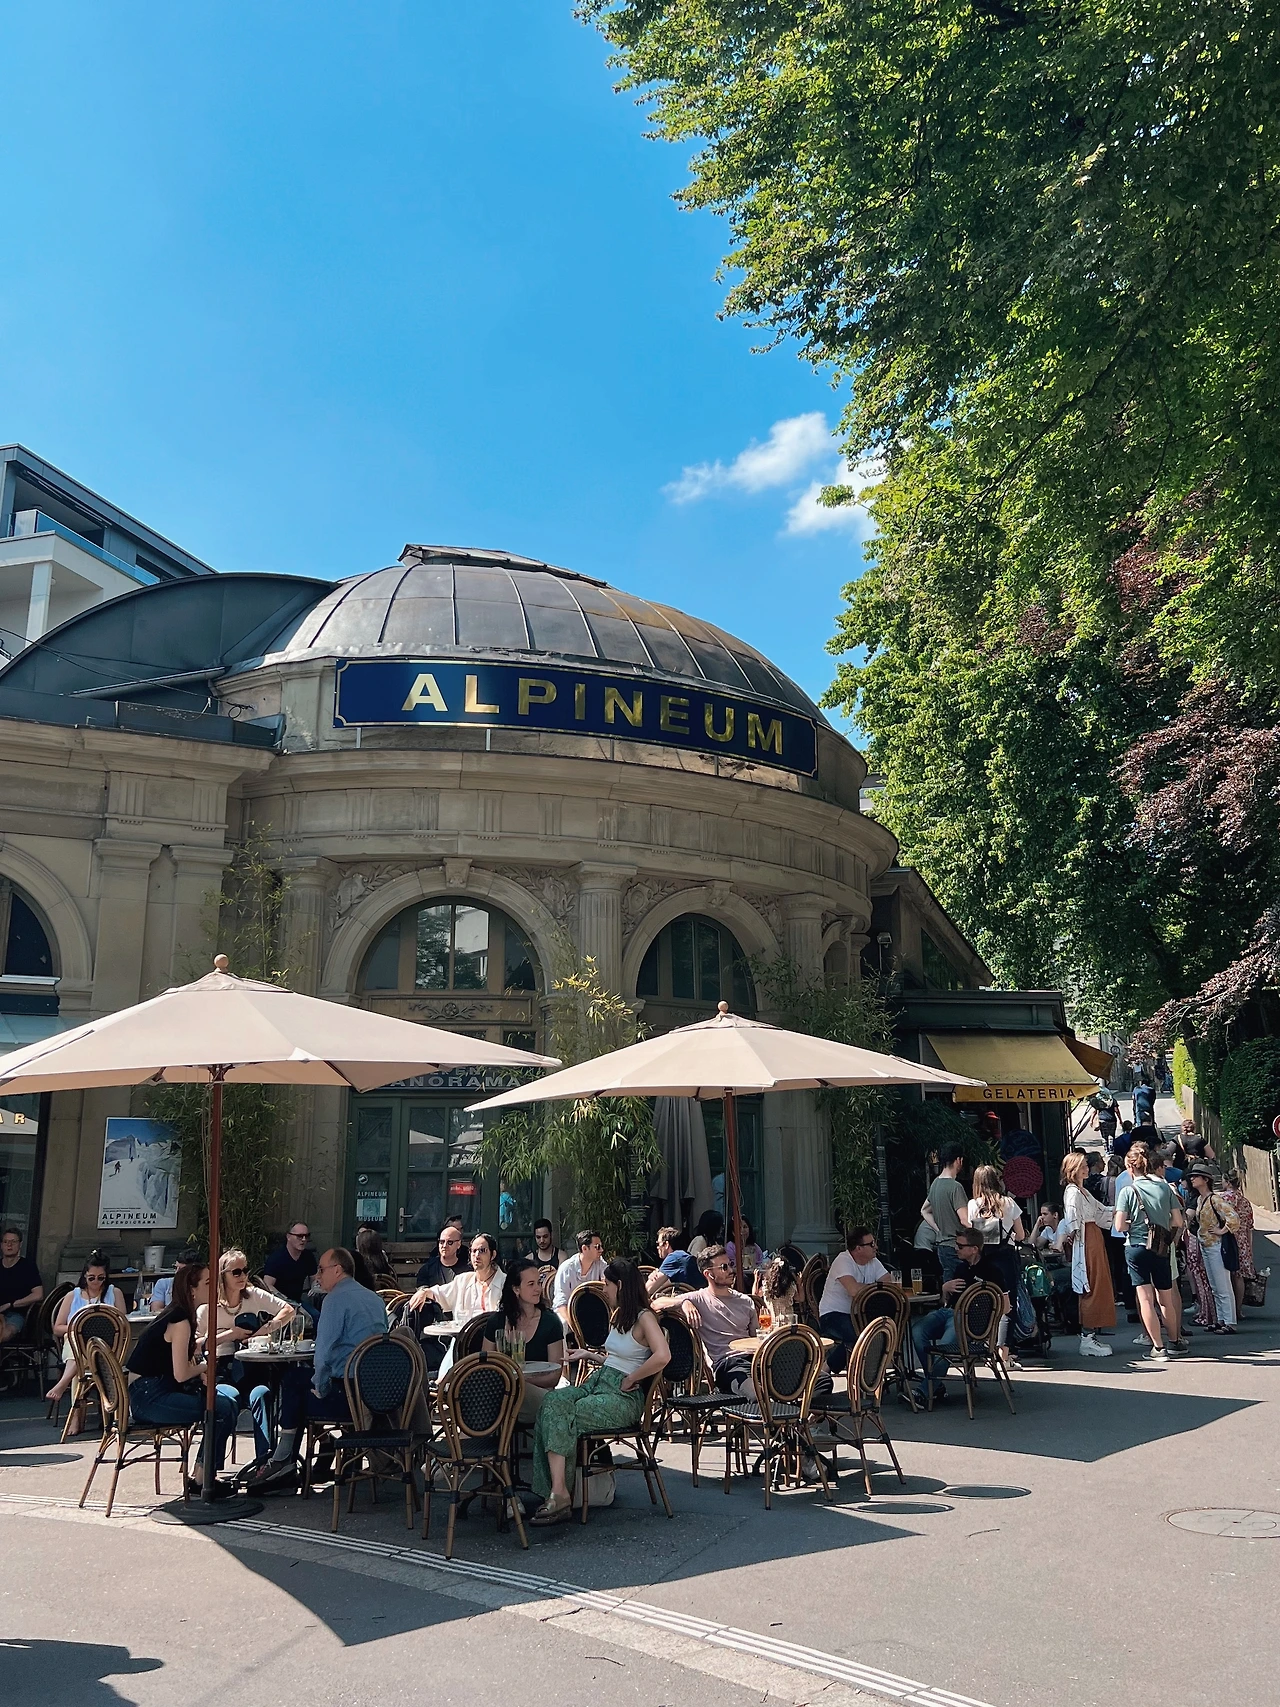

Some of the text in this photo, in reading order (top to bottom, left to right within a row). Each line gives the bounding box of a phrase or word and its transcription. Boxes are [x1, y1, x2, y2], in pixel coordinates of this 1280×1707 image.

[401, 673, 782, 756] ALPINEUM
[390, 1076, 521, 1087] ANORAMA
[983, 1088, 1076, 1099] GELATERIA
